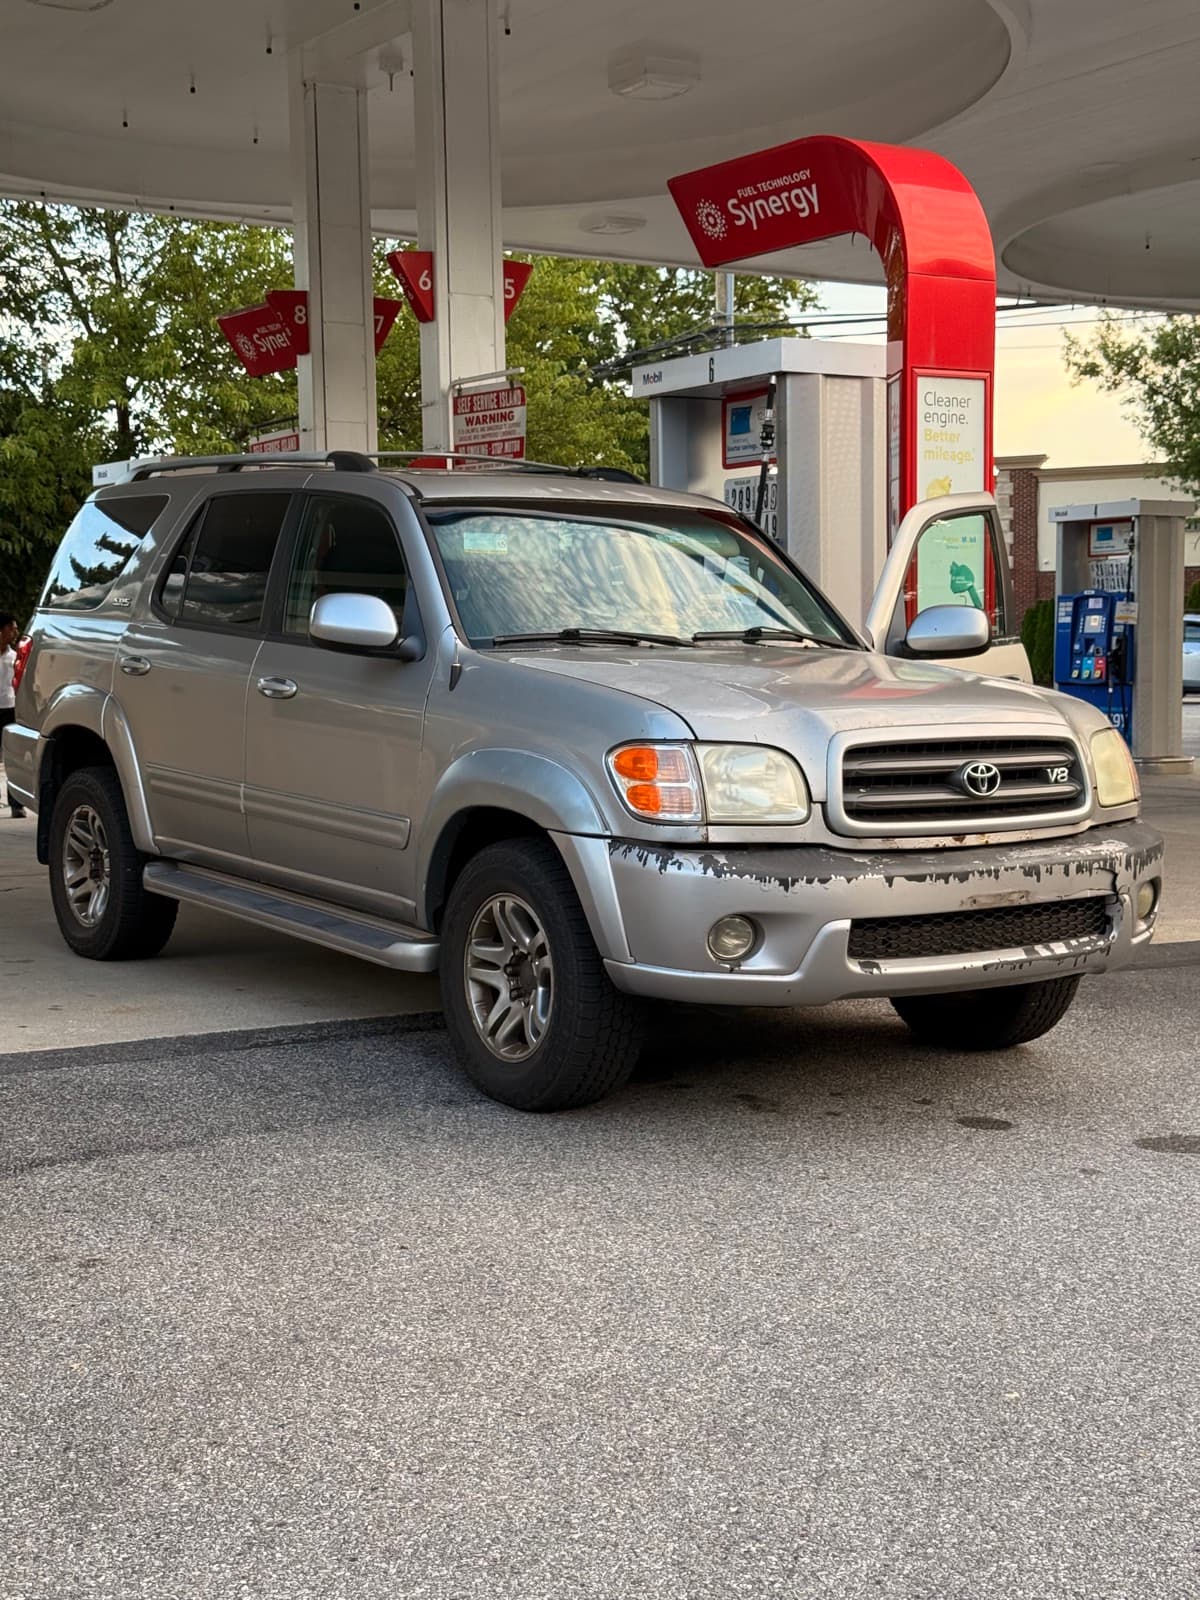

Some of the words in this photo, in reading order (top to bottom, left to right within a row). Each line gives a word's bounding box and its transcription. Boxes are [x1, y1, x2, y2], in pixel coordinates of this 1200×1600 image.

[737, 188, 757, 199] FUEL
[757, 168, 811, 193] TECHNOLOGY
[727, 183, 819, 230] Synergy
[418, 269, 432, 291] 6
[504, 278, 516, 299] 5
[294, 305, 306, 325] 8
[374, 315, 385, 334] 7
[642, 371, 663, 385] Mobil
[708, 357, 715, 383] 6
[457, 396, 471, 414] SELF
[474, 392, 498, 411] SERVICE
[499, 388, 522, 409] ISLAND
[924, 391, 972, 408] Cleaner
[465, 411, 515, 427] WARNING
[924, 410, 969, 428] engine.
[924, 428, 961, 443] Better
[1046, 767, 1069, 783] V8
